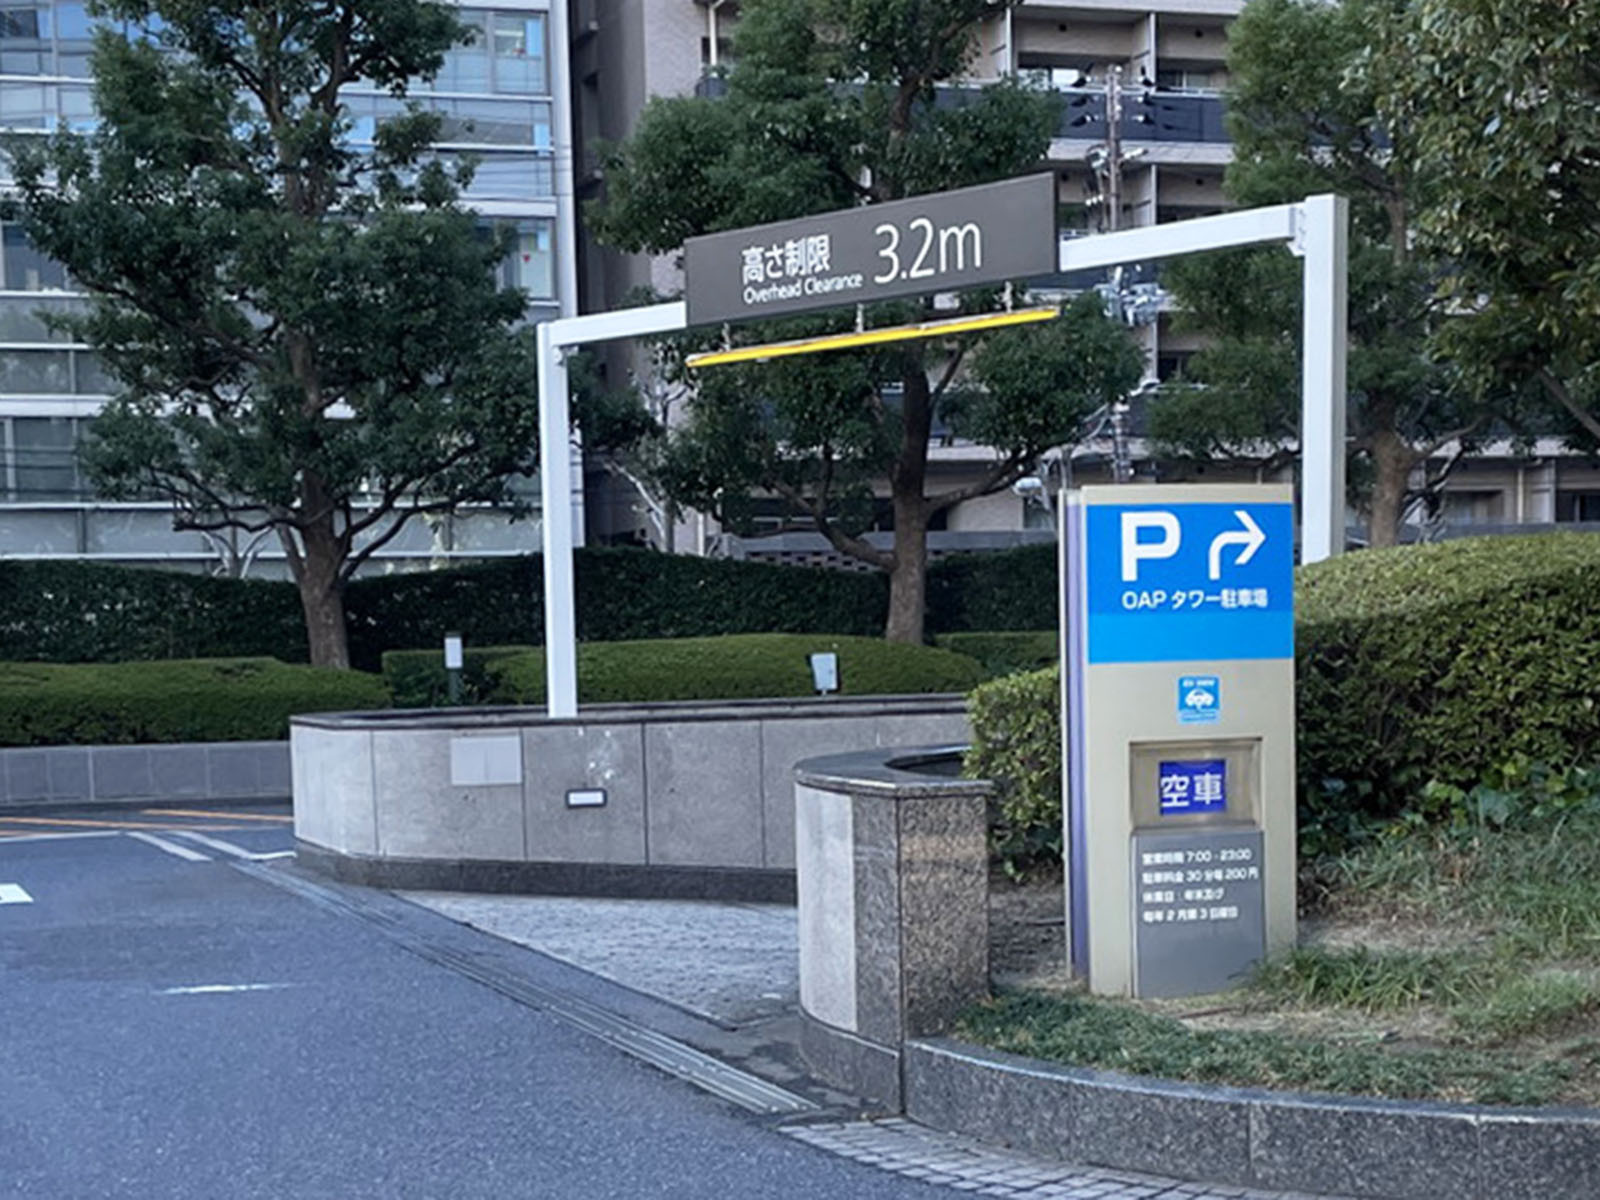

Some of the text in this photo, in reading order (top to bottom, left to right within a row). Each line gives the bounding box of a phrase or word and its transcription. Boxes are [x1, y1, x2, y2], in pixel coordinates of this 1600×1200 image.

[742, 235, 831, 285] 高さ制限
[874, 217, 982, 284] 3.2m
[743, 272, 864, 305] Overhead Clearance
[1121, 511, 1181, 582] P
[1121, 587, 1268, 610] OAP タワー駐車場
[1160, 772, 1223, 808] 空車
